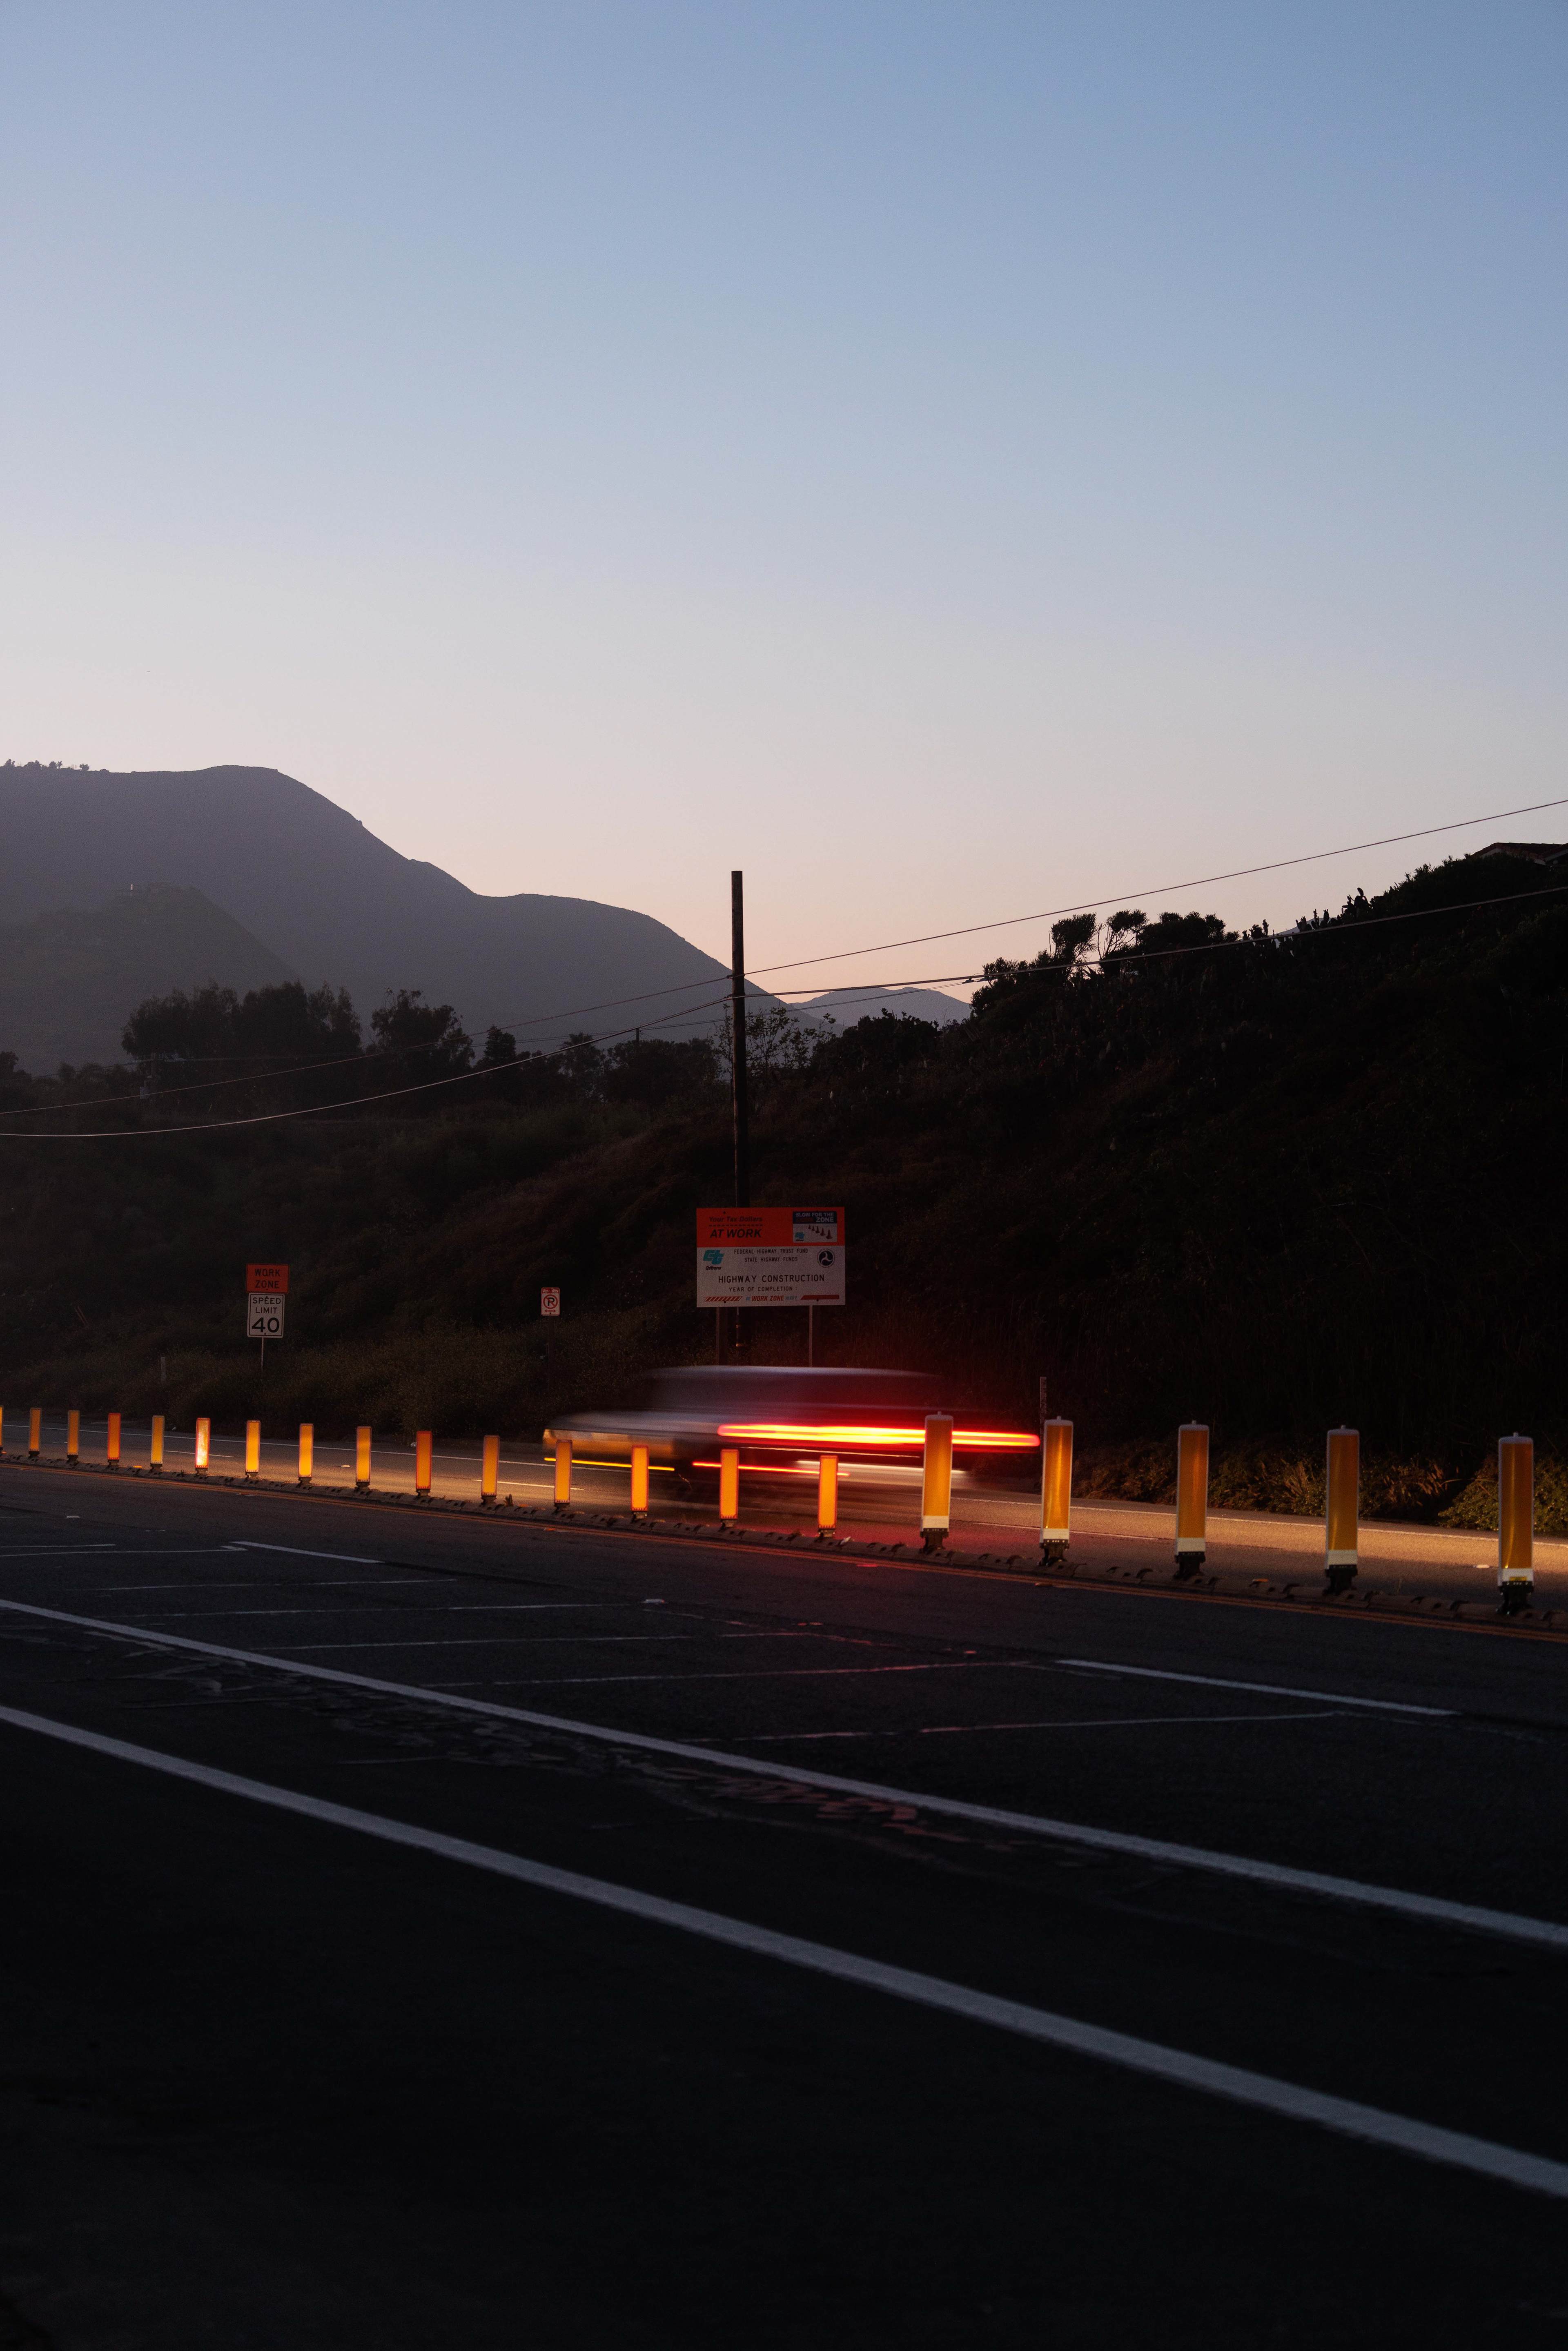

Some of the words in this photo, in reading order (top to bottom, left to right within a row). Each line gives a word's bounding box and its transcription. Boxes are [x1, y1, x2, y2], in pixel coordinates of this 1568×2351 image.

[710, 1229, 724, 1238] AT
[727, 1229, 762, 1238] WORK
[255, 1268, 281, 1277] WORK
[255, 1280, 280, 1288] ZONE
[252, 1317, 279, 1333] 40
